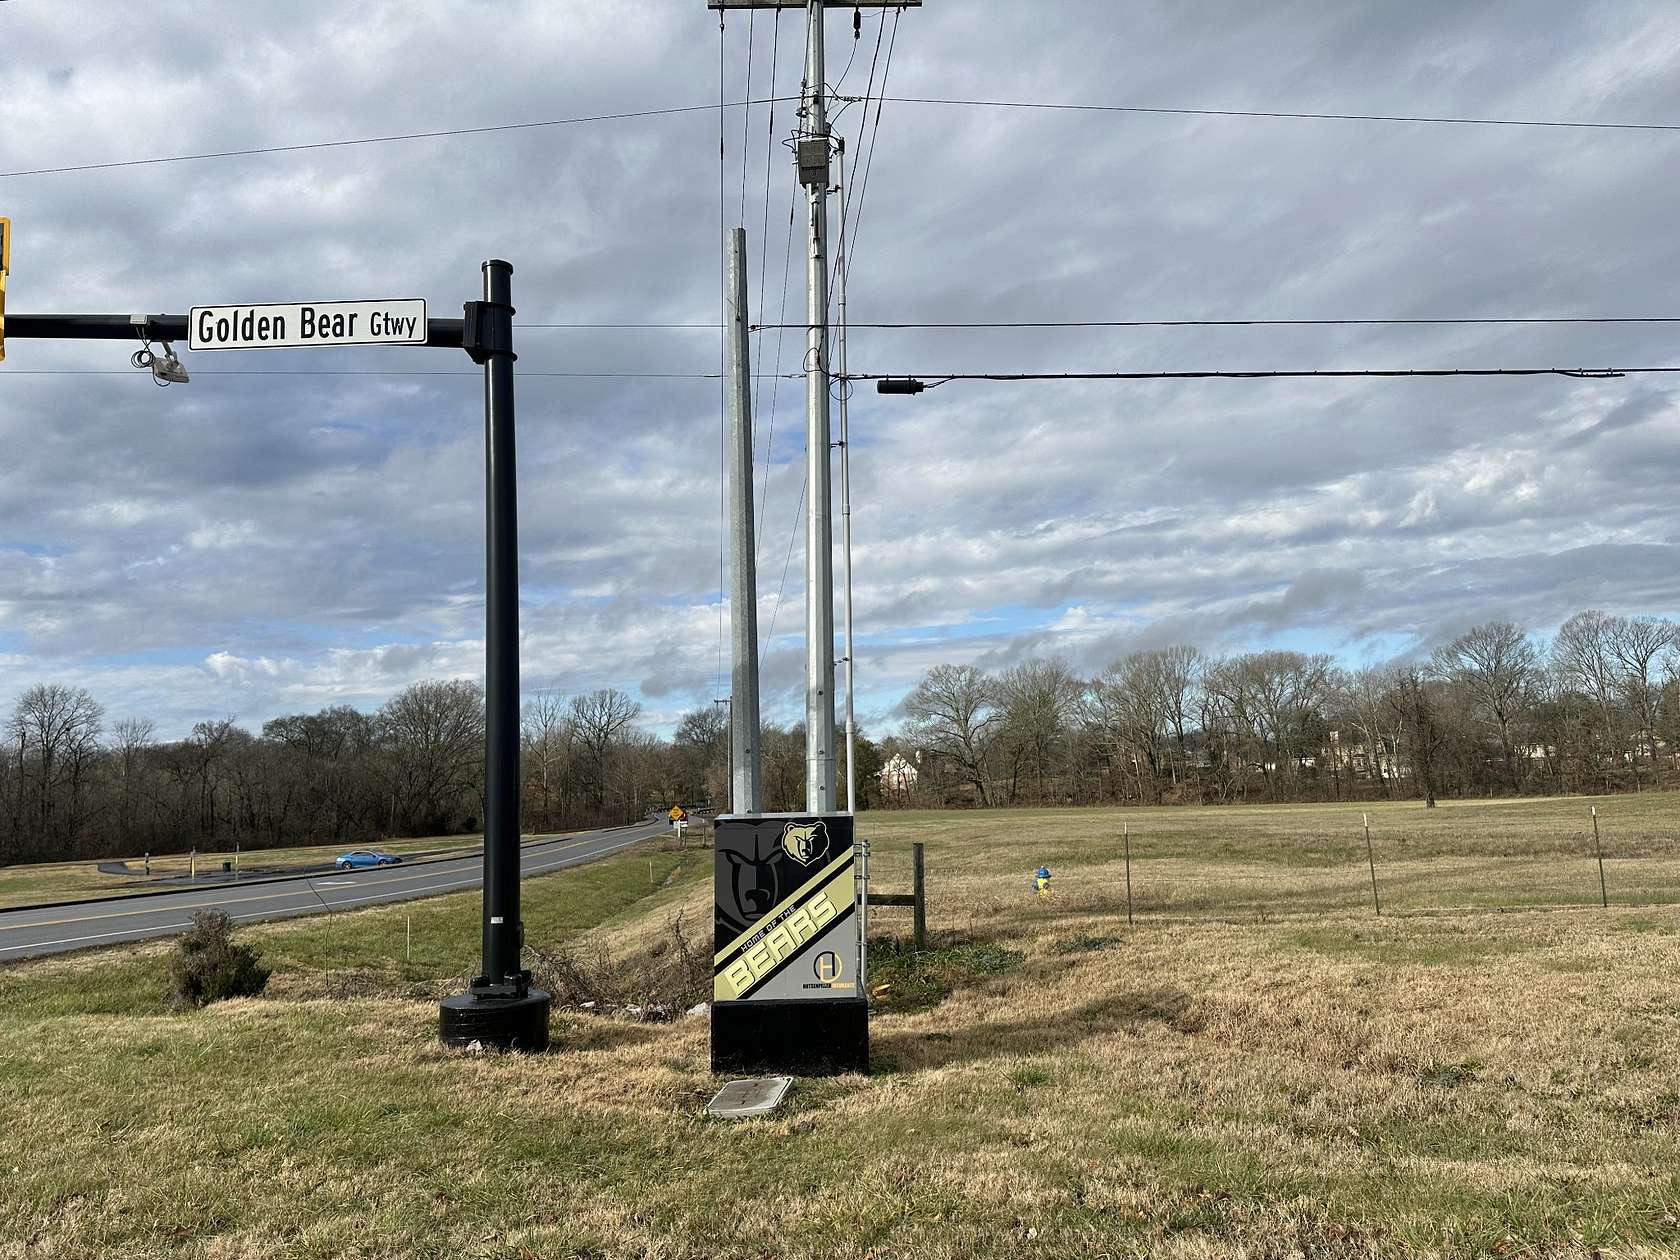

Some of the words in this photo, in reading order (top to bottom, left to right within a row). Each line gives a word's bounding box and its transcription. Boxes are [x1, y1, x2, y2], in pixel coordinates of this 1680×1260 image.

[199, 309, 285, 343] Golden
[301, 307, 358, 339] Bear
[370, 311, 417, 339] Gtwy
[724, 891, 838, 996] BEARS
[740, 931, 766, 952] HOME
[766, 920, 778, 932] OF
[779, 904, 796, 921] THE
